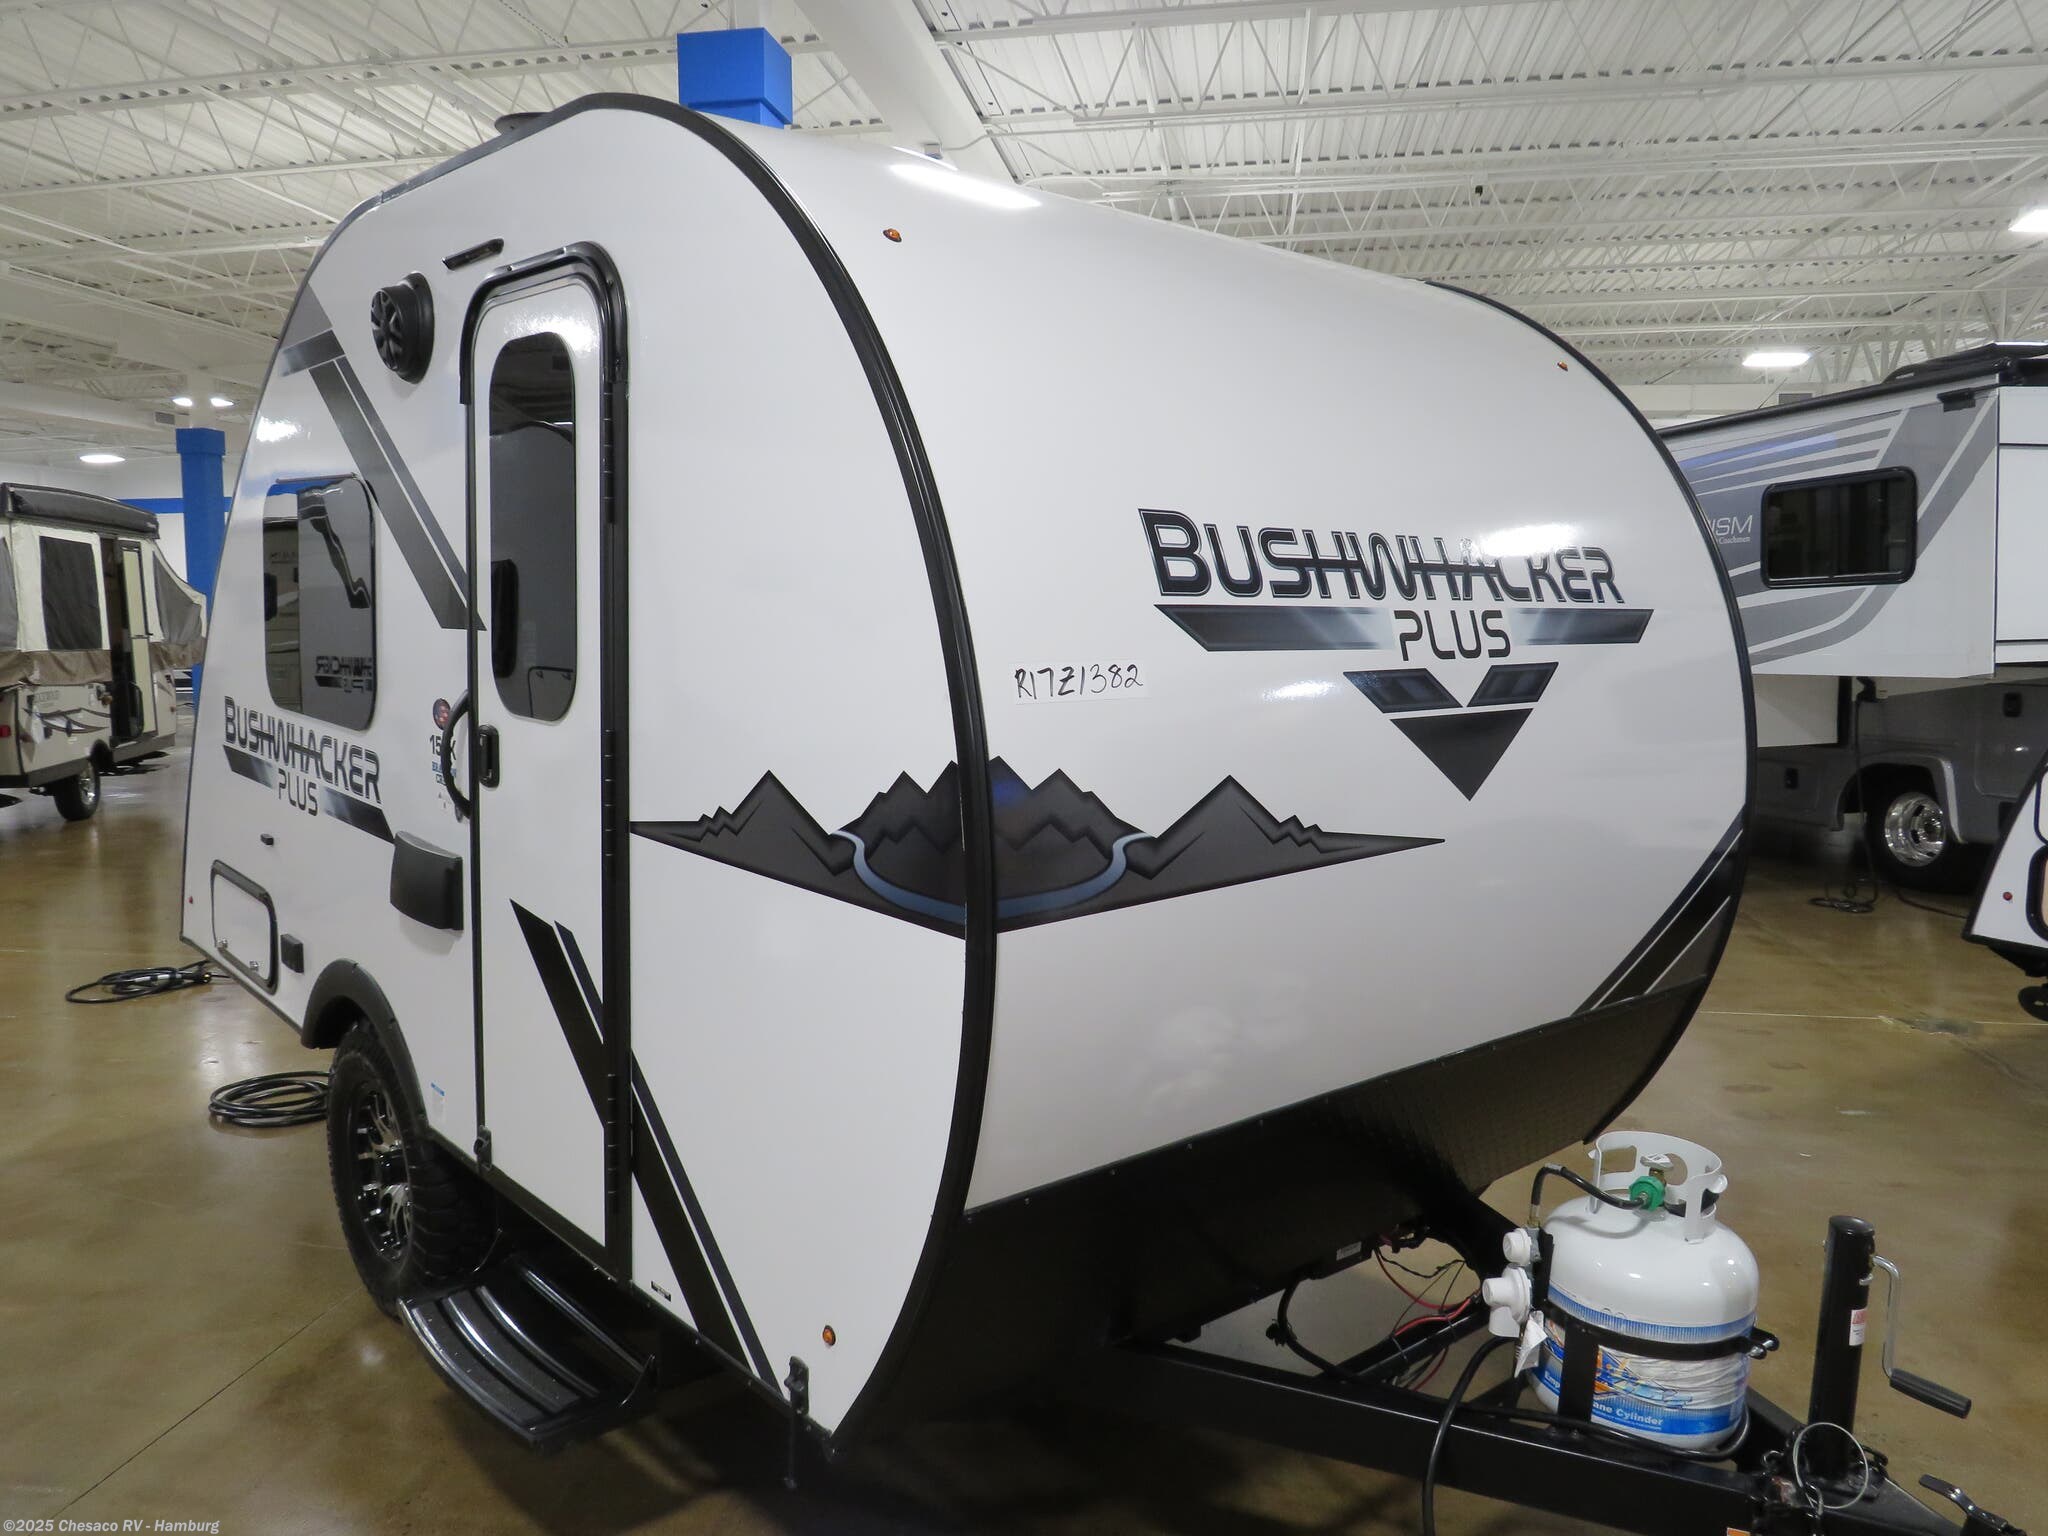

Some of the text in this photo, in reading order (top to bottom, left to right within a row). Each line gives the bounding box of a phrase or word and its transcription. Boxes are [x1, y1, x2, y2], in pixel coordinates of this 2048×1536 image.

[1708, 514, 1753, 535] ISM
[1138, 508, 1625, 604] BUSHWHACKER
[1394, 609, 1512, 661] PLUS
[224, 695, 382, 804] BUSHWHACKER
[278, 767, 318, 817] PLUS
[1615, 1408, 1663, 1426] Cylinder
